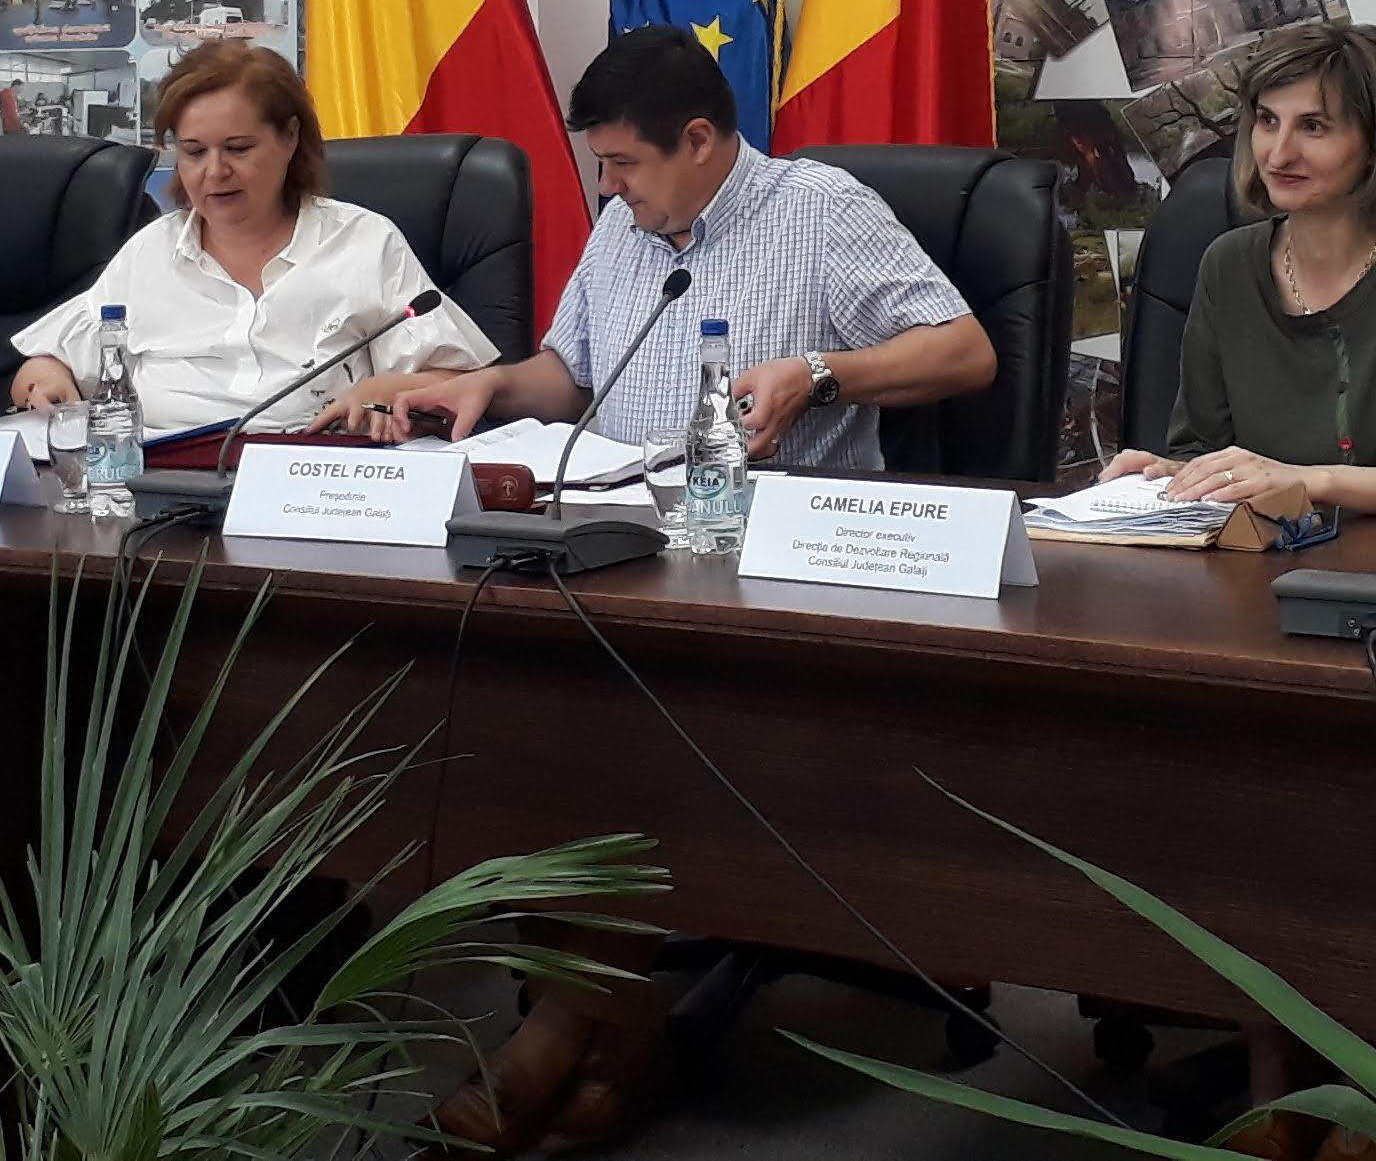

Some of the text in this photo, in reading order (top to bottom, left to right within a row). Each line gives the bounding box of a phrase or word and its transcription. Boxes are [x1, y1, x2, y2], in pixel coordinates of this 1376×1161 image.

[289, 462, 405, 480] COSTEL FOTEA
[692, 477, 720, 487] KEIA
[810, 495, 949, 520] CAMELIA EPURE
[830, 542, 843, 553] de
